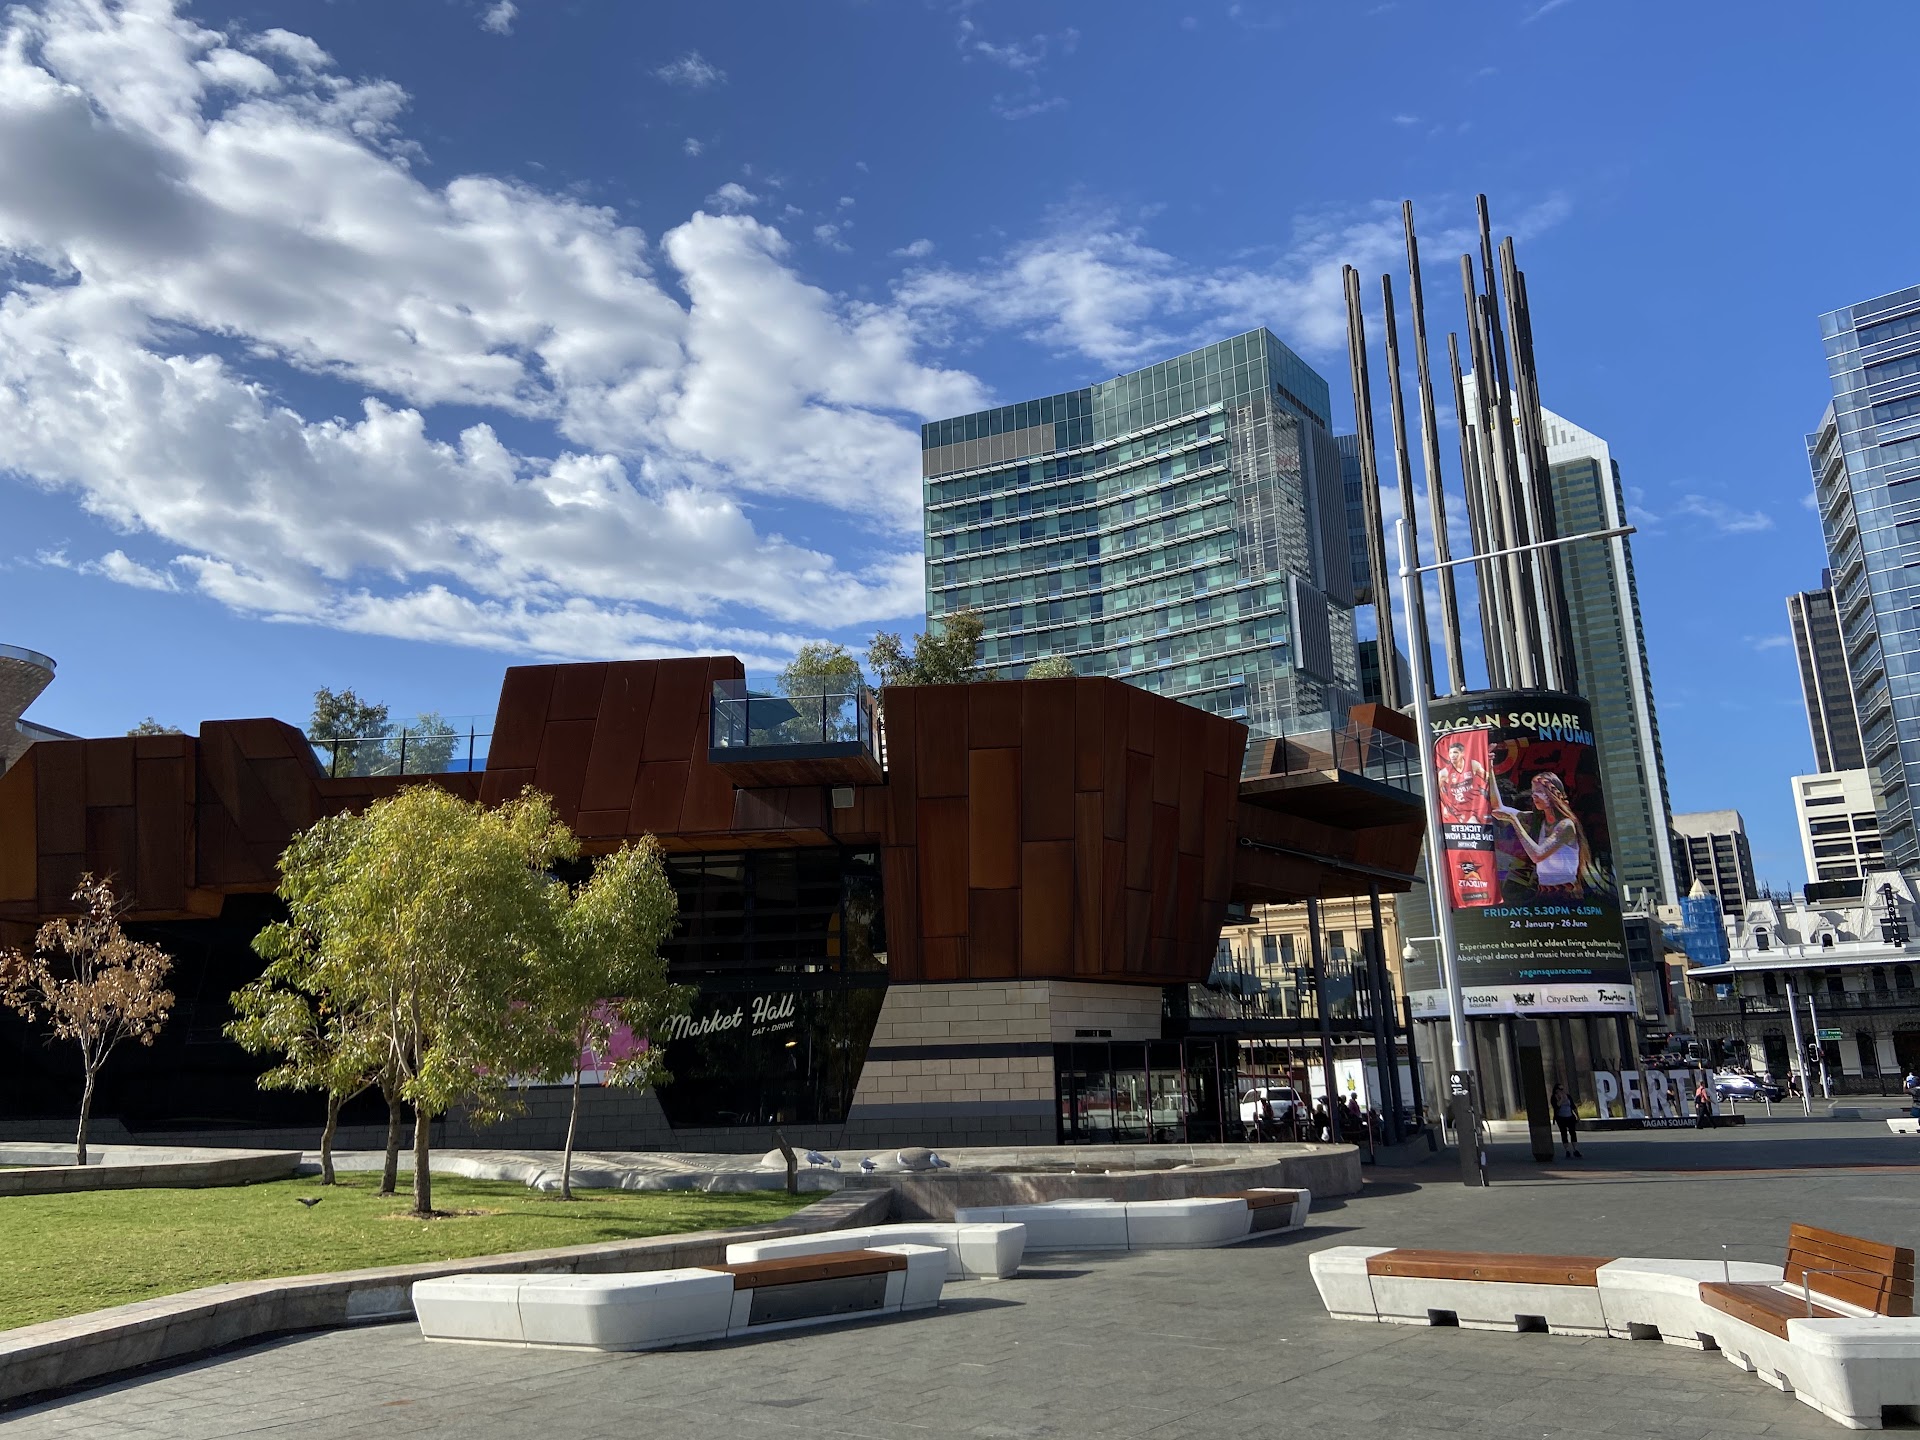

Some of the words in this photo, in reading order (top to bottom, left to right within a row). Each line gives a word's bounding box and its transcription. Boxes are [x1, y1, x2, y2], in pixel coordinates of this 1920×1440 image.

[1430, 714, 1501, 733] YAGAN
[1508, 712, 1580, 730] SQUARE
[1538, 726, 1594, 746] NYUMBI
[1483, 907, 1533, 917] FRIDAYS,
[1534, 906, 1570, 915] 5.30PM
[1577, 906, 1602, 915] 6.15PM
[1888, 899, 1898, 935] ROYAL
[1510, 920, 1521, 929] 24
[1525, 920, 1554, 929] January
[1561, 919, 1571, 927] 26
[1572, 919, 1588, 927] June
[1459, 942, 1499, 952] Experience
[1501, 940, 1514, 949] the
[1516, 939, 1543, 948] world's
[1544, 939, 1567, 947] oldest
[1567, 939, 1586, 949] living
[1586, 939, 1606, 947] culture
[1457, 952, 1494, 963] Aboriginal
[1495, 951, 1518, 960] dance
[1520, 951, 1534, 959] and
[1536, 950, 1558, 958] music
[1560, 950, 1575, 958] here
[1519, 968, 1592, 978] yagansquare.com.au
[1467, 995, 1498, 1003] YAGAN
[1547, 995, 1561, 1004] City
[1561, 995, 1568, 1003] of
[1570, 995, 1589, 1003] Perth
[660, 1006, 743, 1041] Market
[752, 993, 795, 1024] Hall
[752, 1027, 765, 1036] EAT
[771, 1021, 795, 1032] DRINK
[1642, 1119, 1667, 1128] YAGAN
[1668, 1118, 1697, 1127] SQUARE
